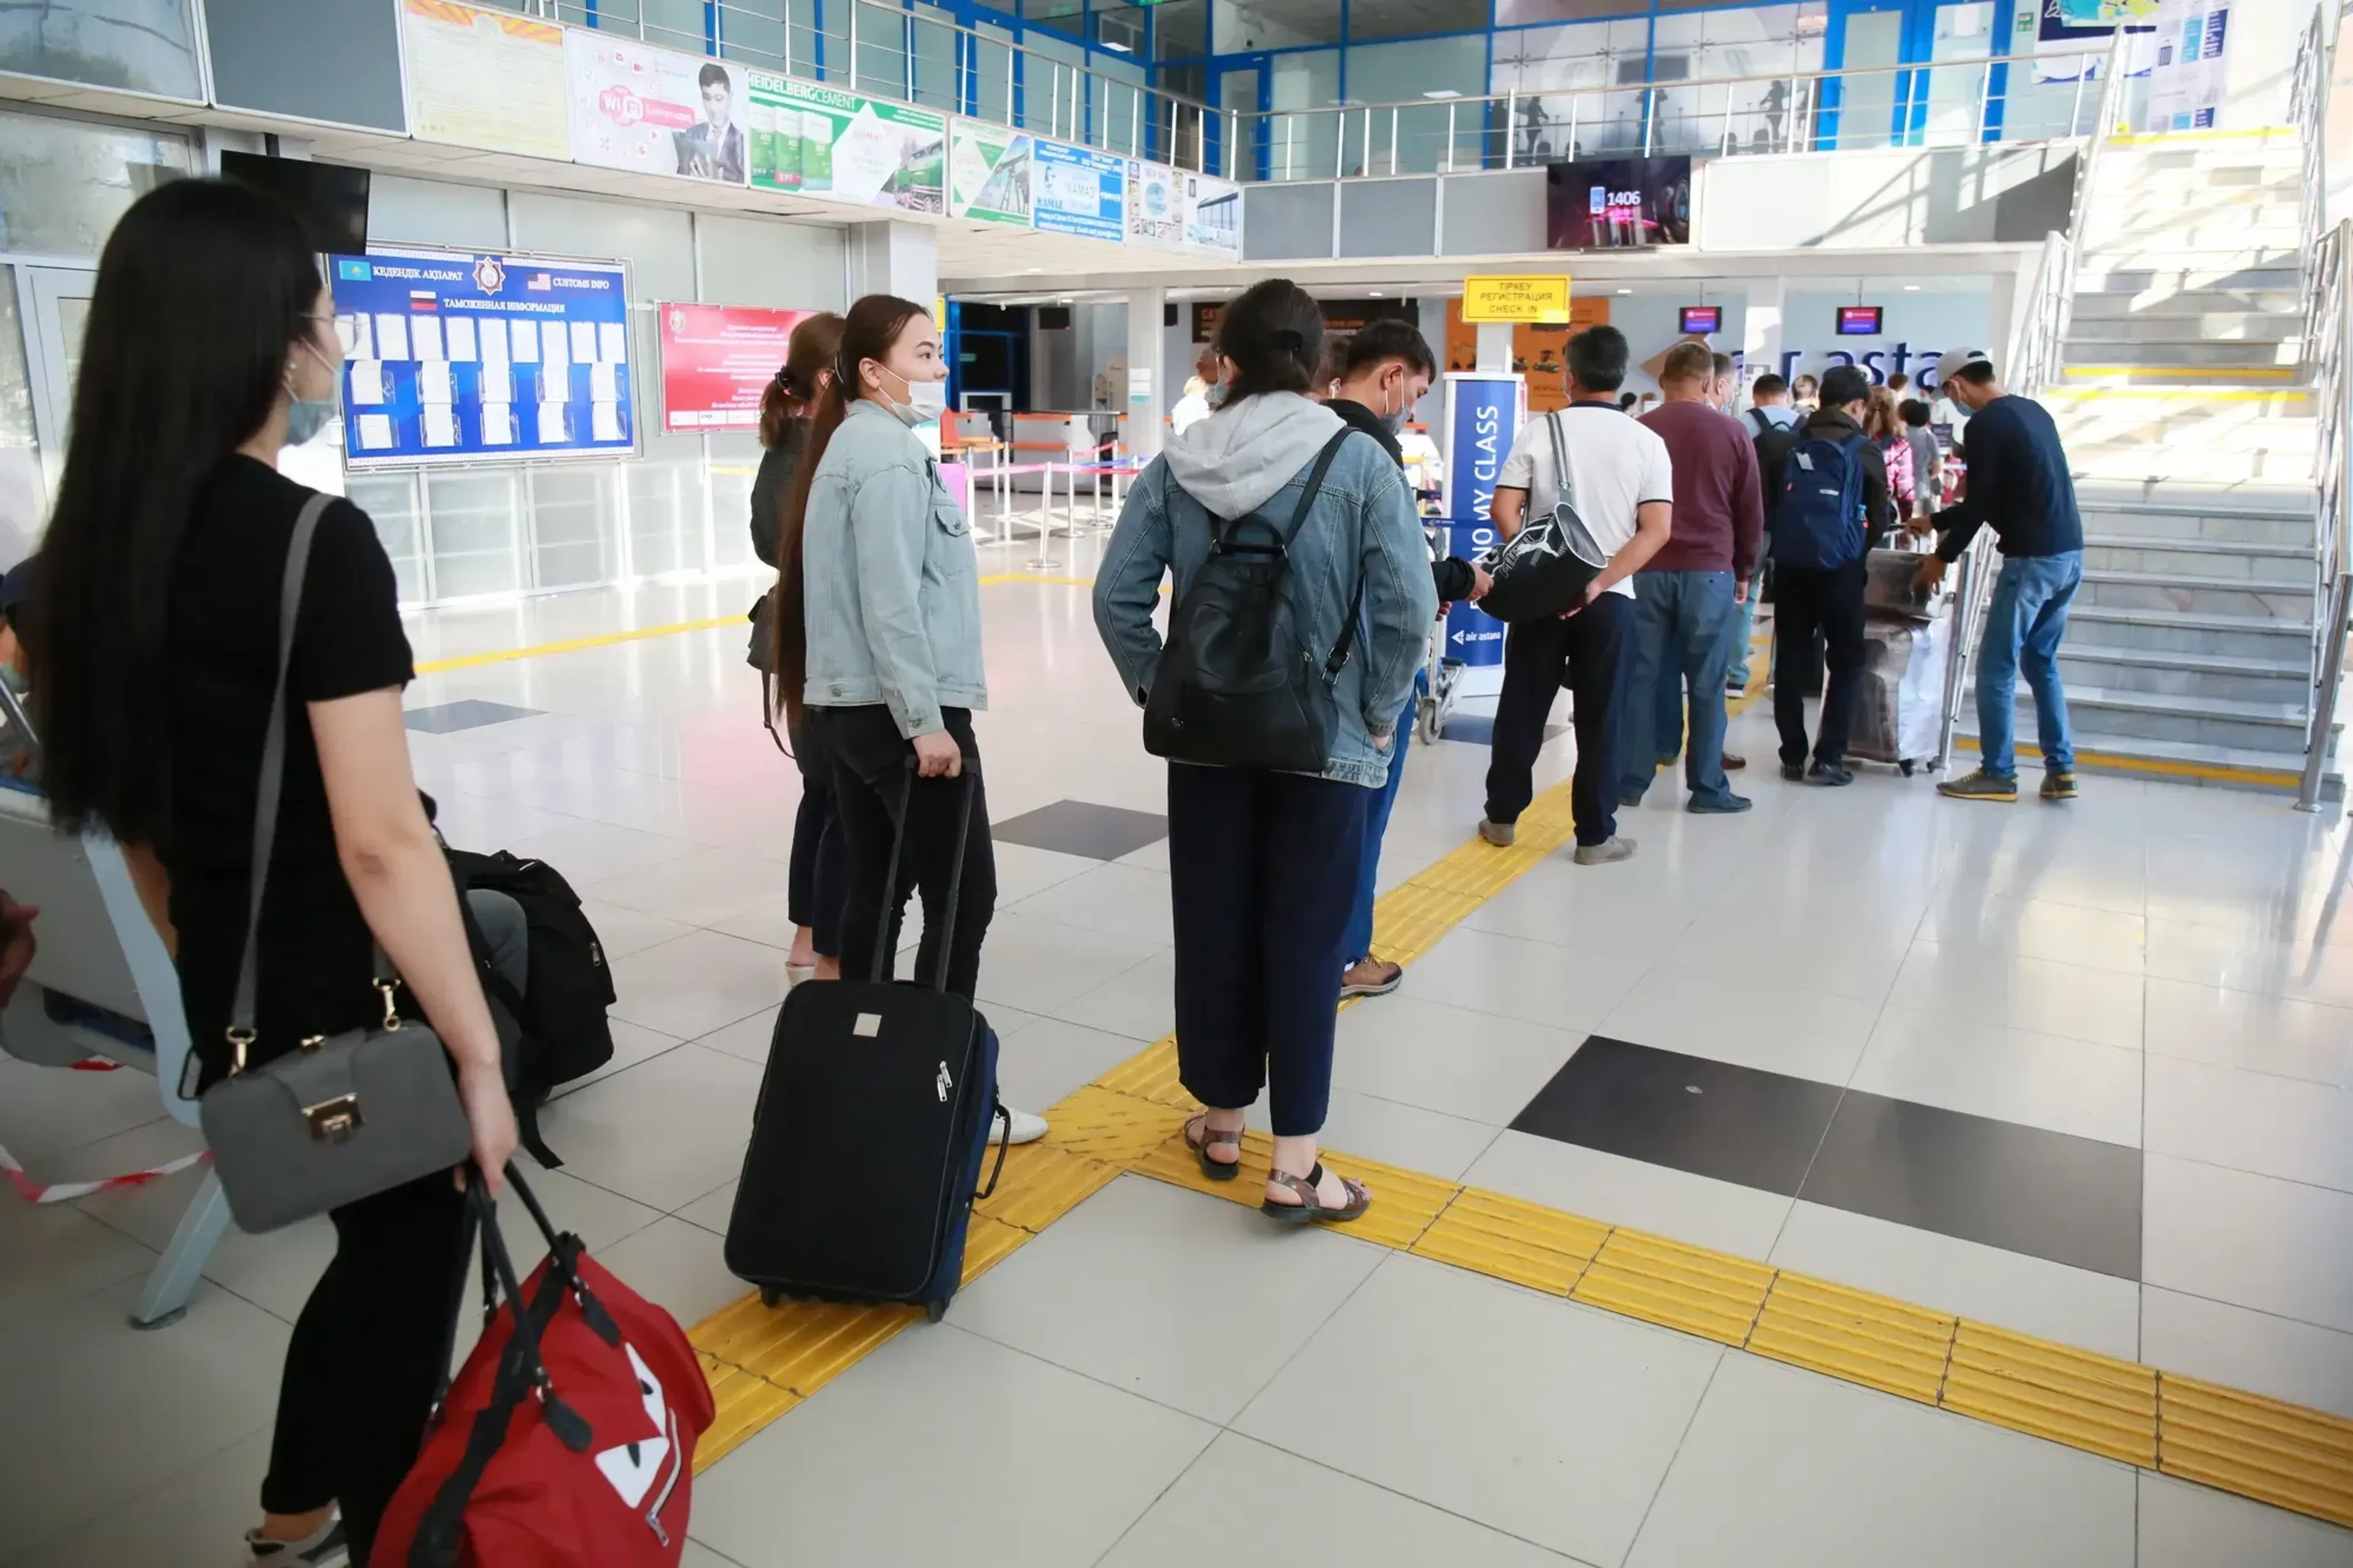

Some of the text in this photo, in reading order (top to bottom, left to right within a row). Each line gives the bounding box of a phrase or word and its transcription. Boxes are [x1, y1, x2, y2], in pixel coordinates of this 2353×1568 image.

[1607, 191, 1641, 205] 1406
[553, 278, 610, 289] CUSTOMS INFO
[1480, 292, 1553, 301] РЕГИСТРАЦИЯ
[444, 298, 565, 314] ТАМОЖЕННАЯ ИНФОРМАЦИЯ
[1489, 305, 1537, 313] CHECK IN
[1474, 405, 1498, 481] CLASS
[1465, 632, 1501, 642] air astana
